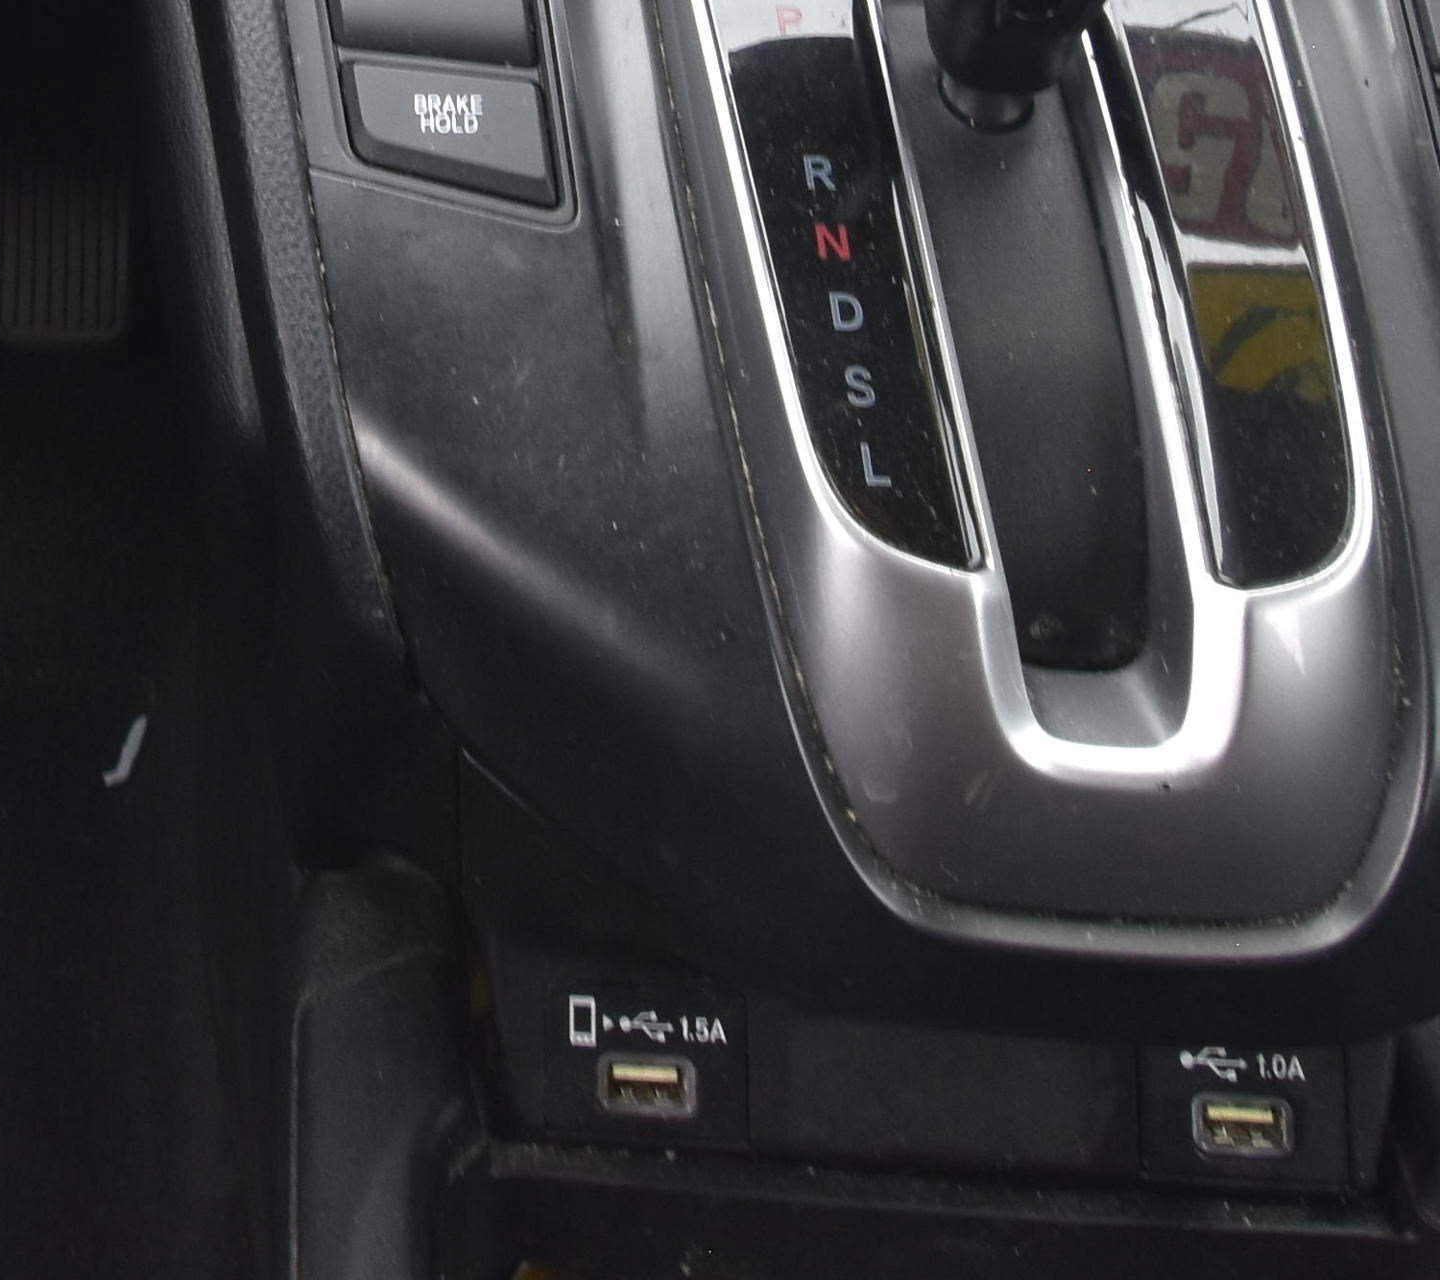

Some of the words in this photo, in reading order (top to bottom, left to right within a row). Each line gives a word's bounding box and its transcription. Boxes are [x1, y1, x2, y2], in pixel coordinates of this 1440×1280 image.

[775, 4, 804, 37] P
[413, 93, 484, 116] BRAKE
[420, 113, 479, 135] HOLD
[802, 154, 835, 192] R
[813, 222, 853, 263] N
[828, 290, 865, 333] D
[843, 364, 878, 409] S
[861, 441, 892, 489] L
[678, 1016, 728, 1045] 1.5A
[1256, 1052, 1307, 1081] 1.0A
